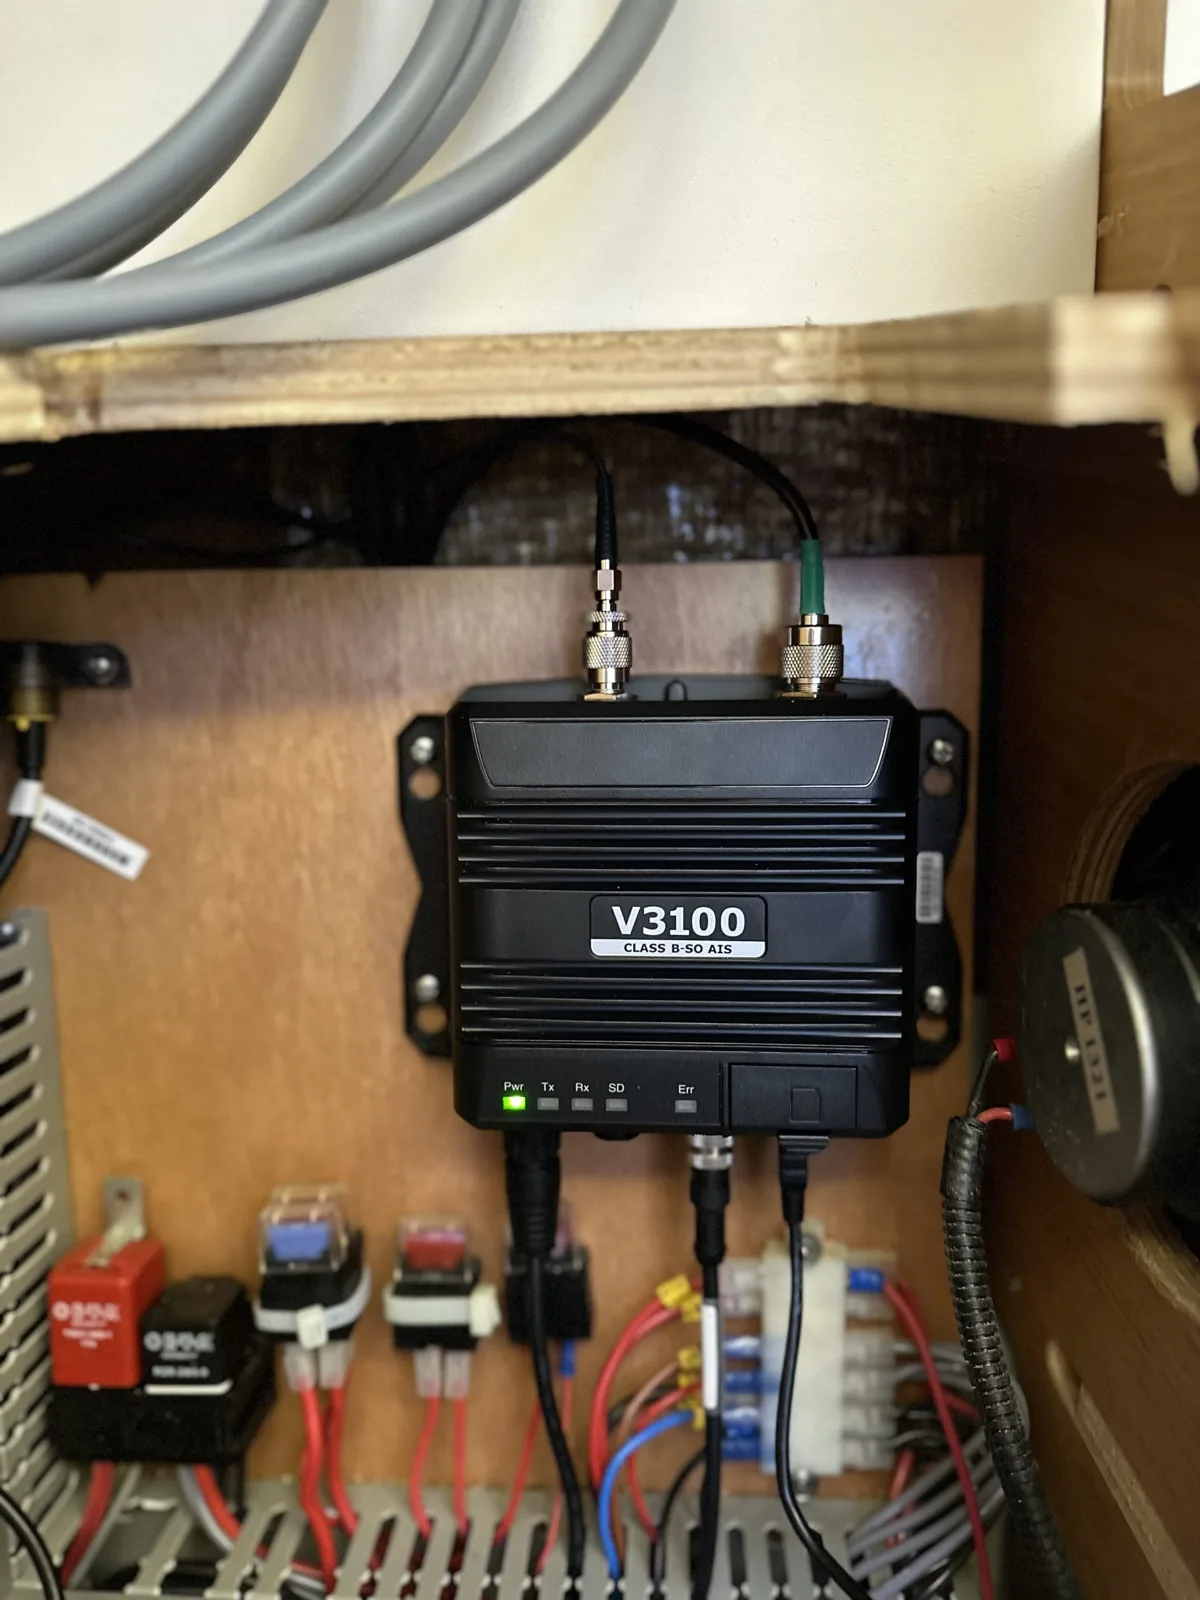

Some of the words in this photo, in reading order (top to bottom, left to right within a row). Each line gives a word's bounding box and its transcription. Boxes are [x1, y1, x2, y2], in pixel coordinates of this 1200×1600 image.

[611, 905, 746, 937] V3100
[623, 942, 666, 953] CLASS
[671, 943, 704, 954] B-SO
[707, 944, 733, 955] AIS
[503, 1081, 525, 1092] Pwr
[541, 1081, 555, 1092] Tx
[575, 1082, 590, 1092] Rx
[608, 1082, 625, 1093] SD
[678, 1084, 695, 1094] Err
